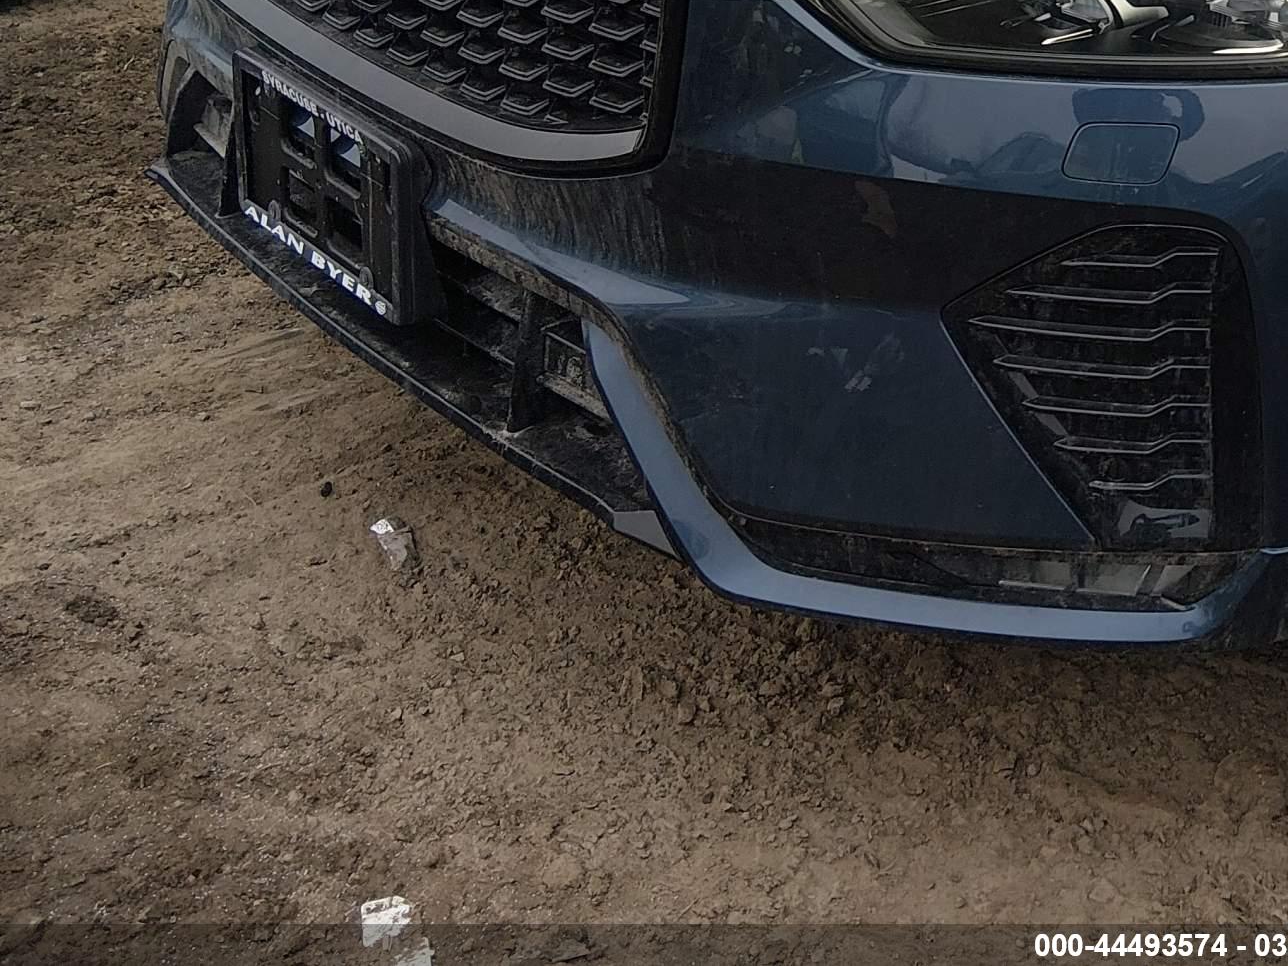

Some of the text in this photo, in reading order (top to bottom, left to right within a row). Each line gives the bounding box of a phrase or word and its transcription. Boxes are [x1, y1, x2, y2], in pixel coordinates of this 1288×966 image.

[262, 70, 364, 145] SYRACUSE UTICA
[245, 206, 372, 305] ALAN BYER
